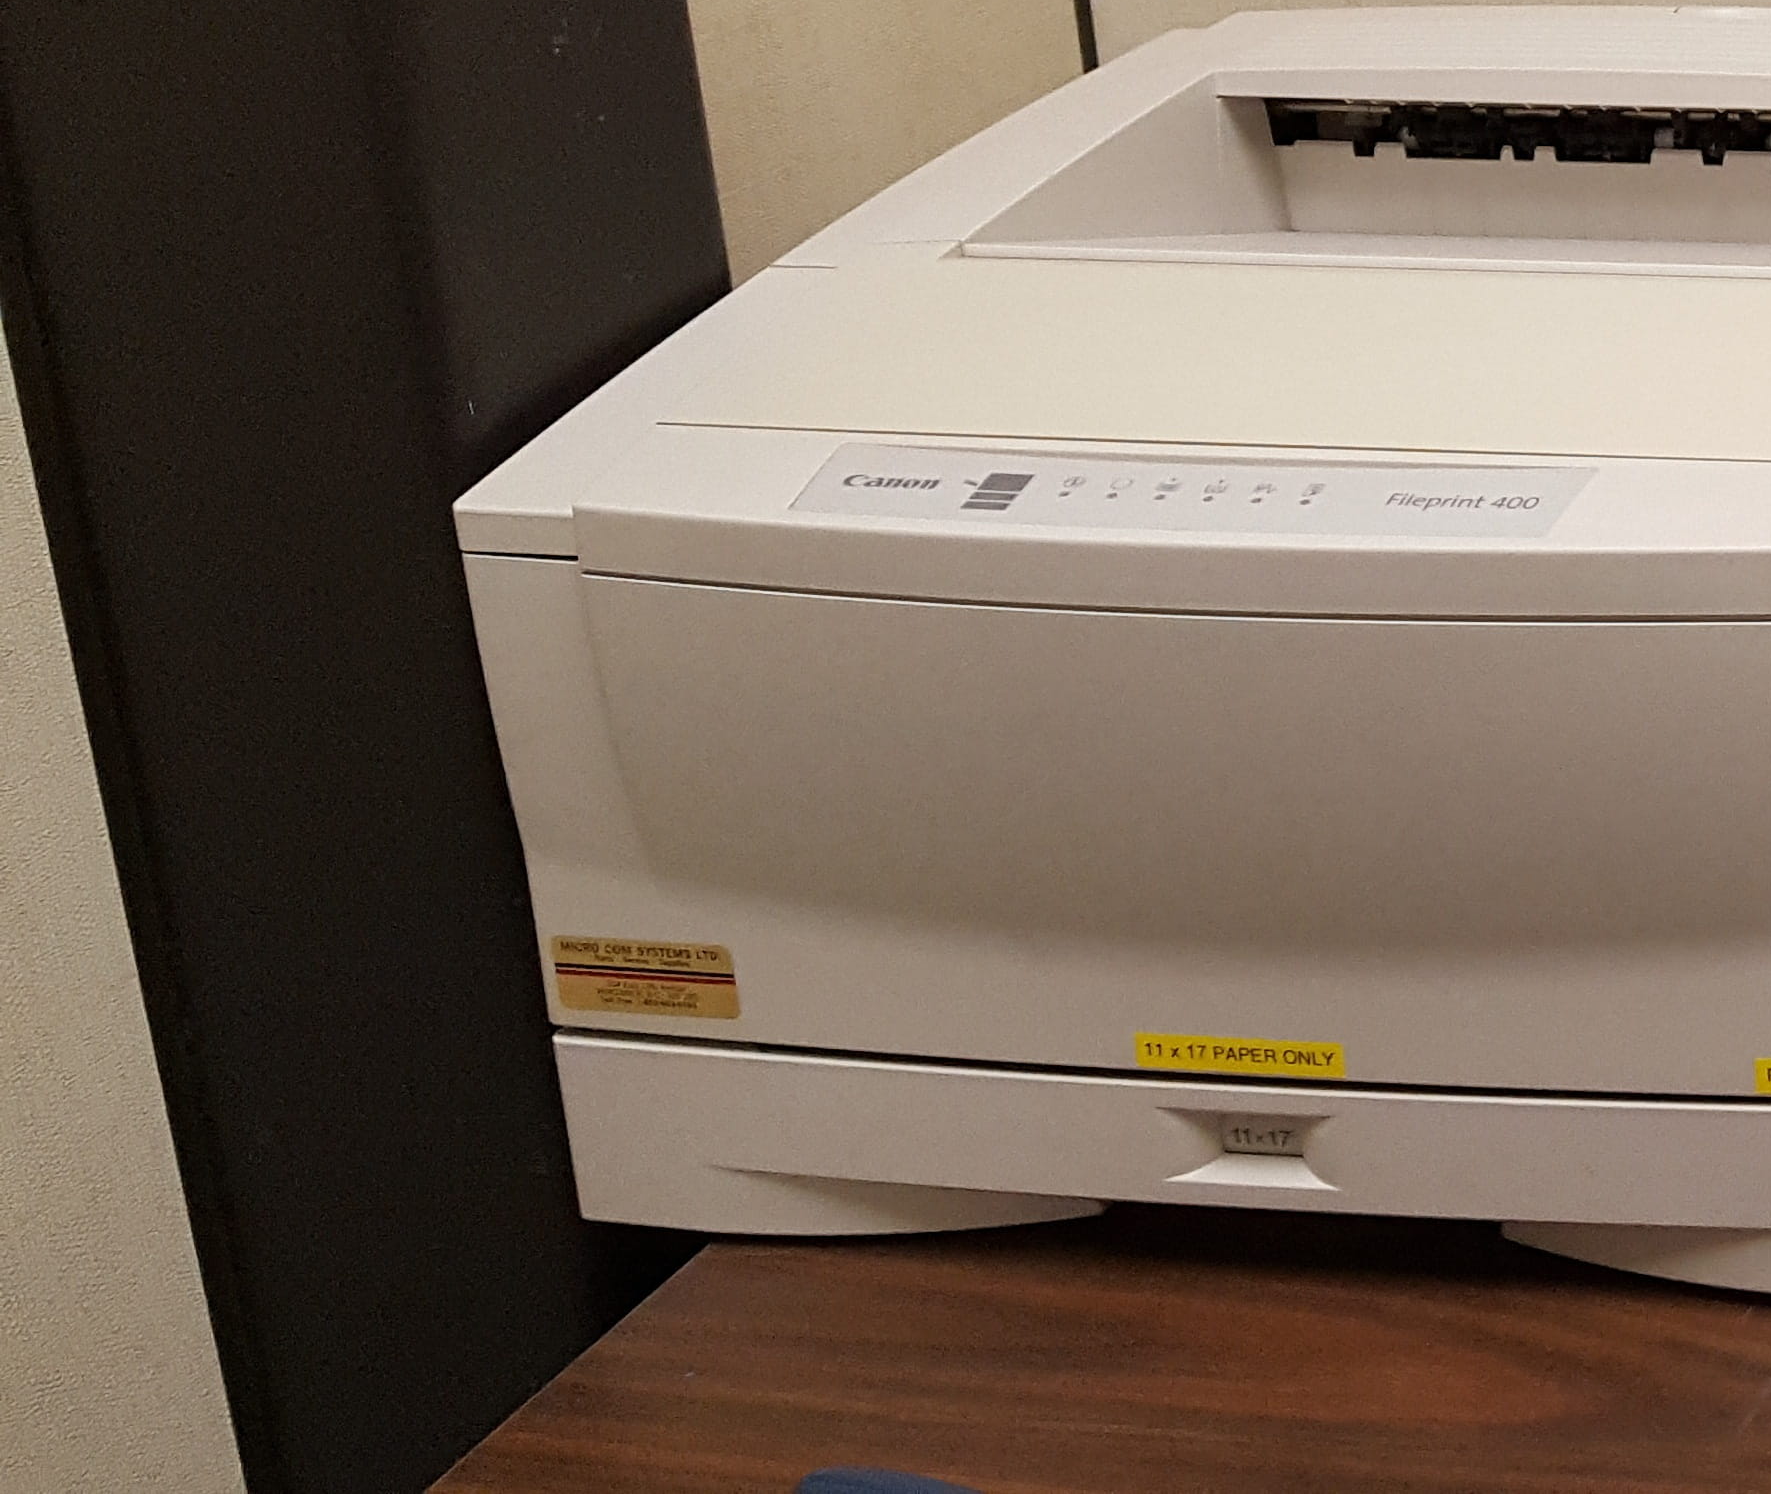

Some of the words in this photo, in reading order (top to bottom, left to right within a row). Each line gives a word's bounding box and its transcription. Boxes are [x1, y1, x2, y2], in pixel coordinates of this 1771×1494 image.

[842, 473, 941, 490] Canon
[1386, 492, 1486, 511] Fileprint
[1490, 496, 1540, 510] 400
[560, 941, 599, 954] MICRO
[604, 944, 632, 955] COM
[637, 946, 691, 959] SYSTEMS
[1144, 1042, 1162, 1056] 11
[1171, 1048, 1180, 1058] x
[1187, 1044, 1206, 1058] 17
[1213, 1046, 1278, 1064] PAPER
[1282, 1049, 1336, 1066] ONLY
